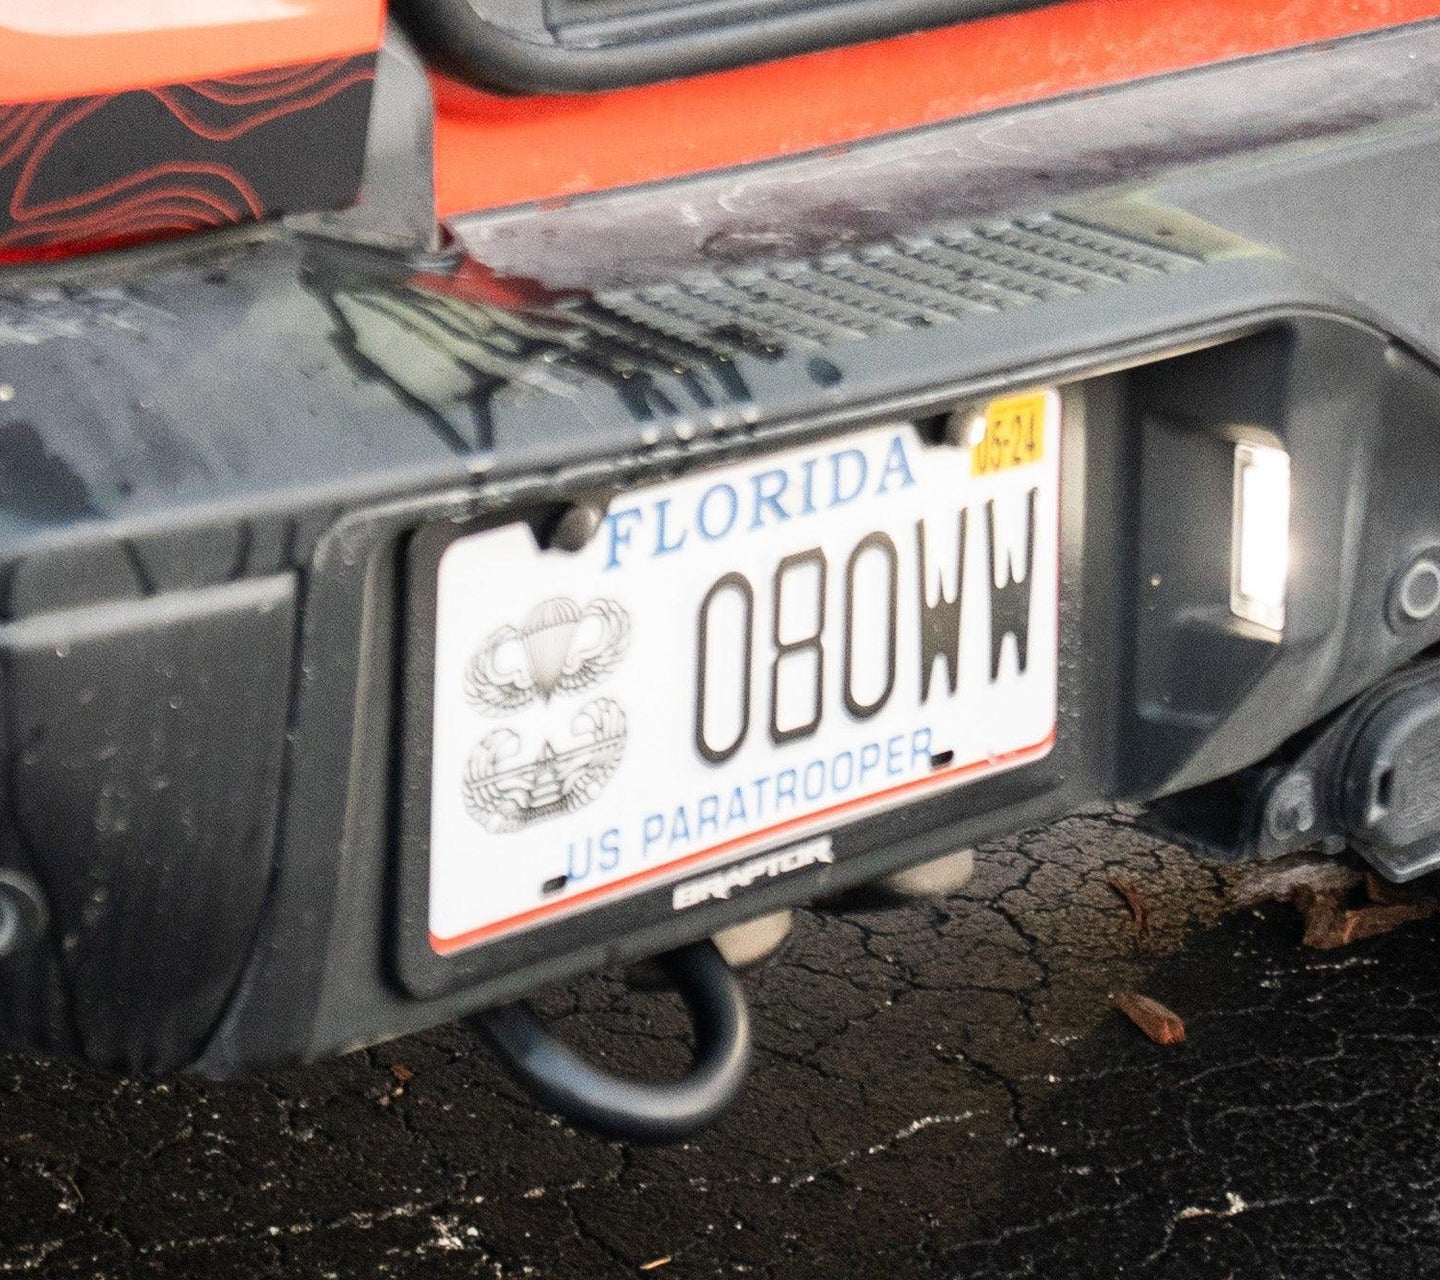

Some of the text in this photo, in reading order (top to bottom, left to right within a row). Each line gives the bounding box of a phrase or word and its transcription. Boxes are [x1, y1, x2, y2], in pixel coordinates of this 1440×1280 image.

[602, 434, 917, 571] FLORIDA
[567, 728, 932, 886] US PARATROOPER
